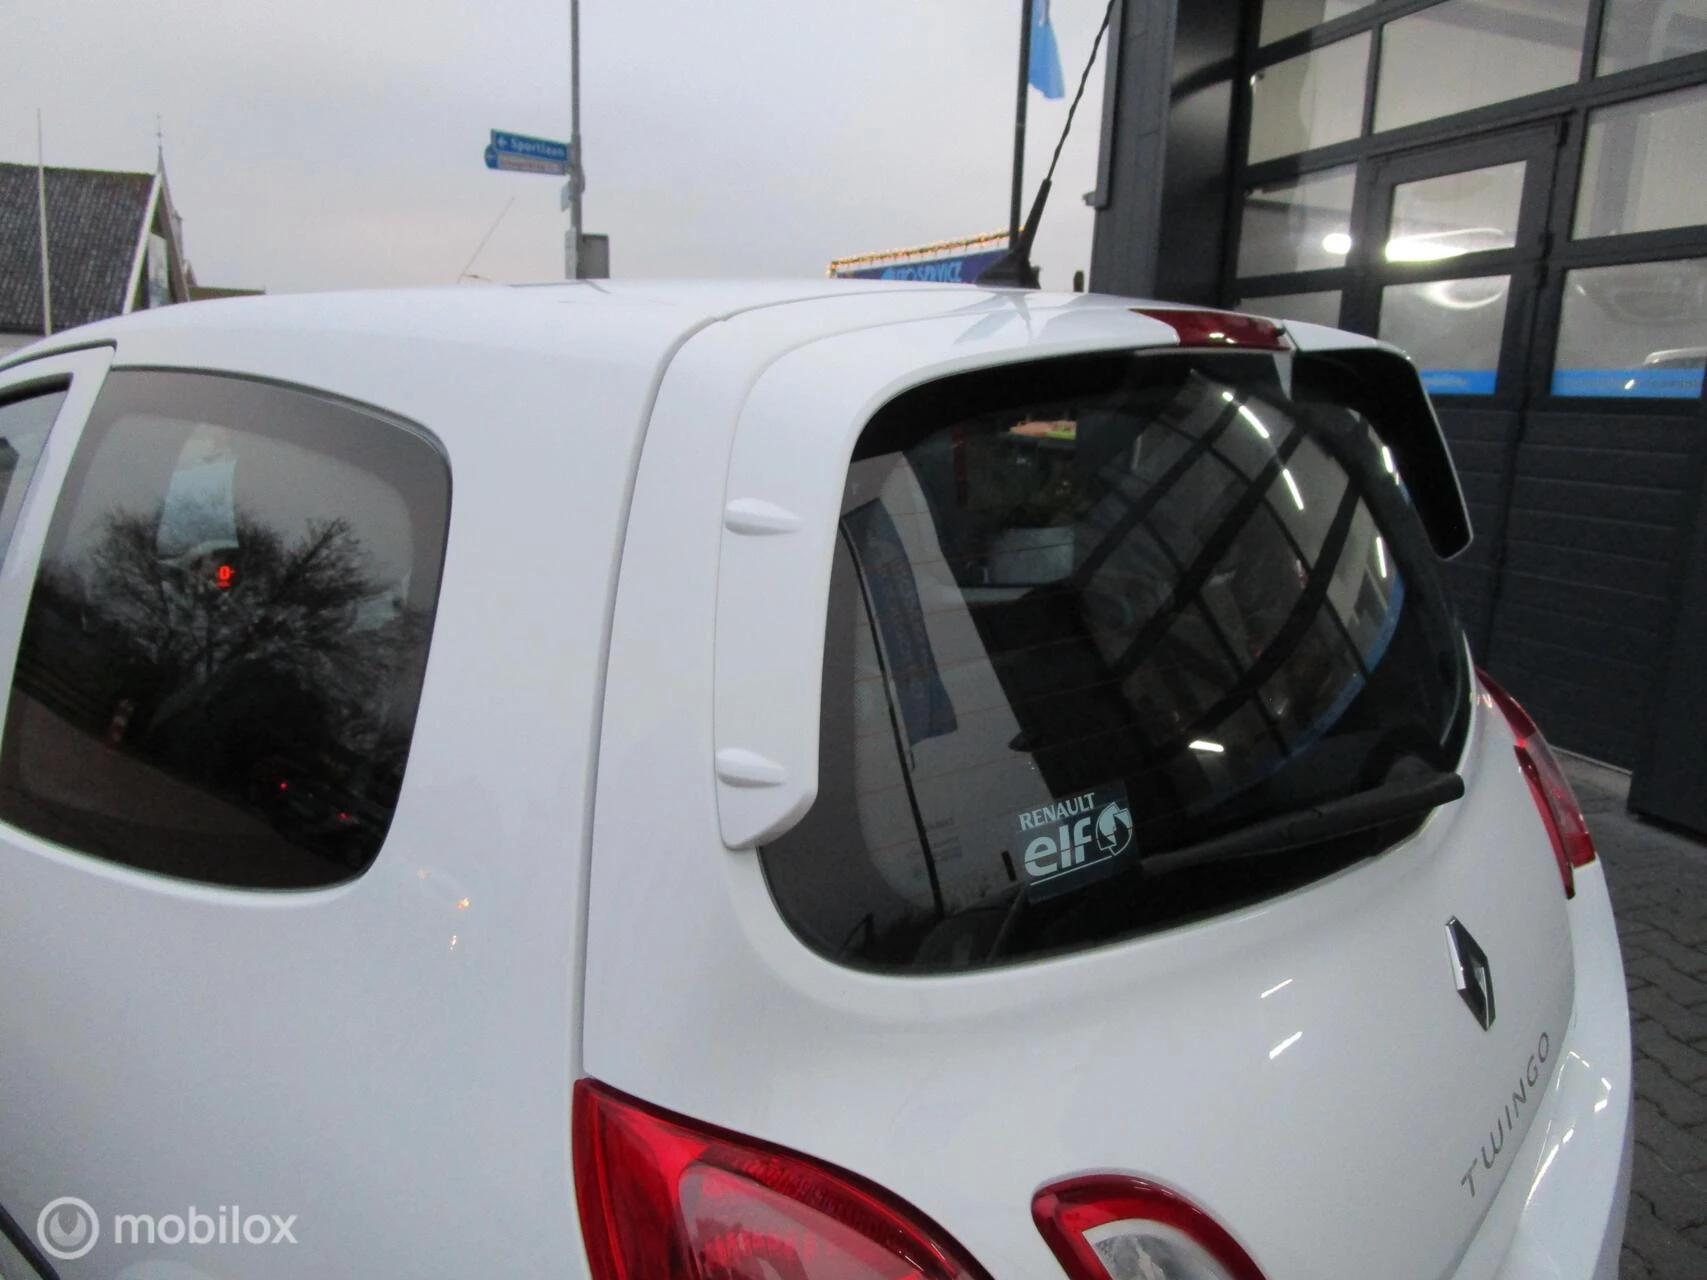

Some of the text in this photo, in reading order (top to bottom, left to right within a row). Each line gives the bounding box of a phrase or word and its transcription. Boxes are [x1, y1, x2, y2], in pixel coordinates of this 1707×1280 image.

[1019, 792, 1095, 831] RENAULT
[1024, 816, 1092, 877] elf
[1461, 1032, 1549, 1197] TWINGO
